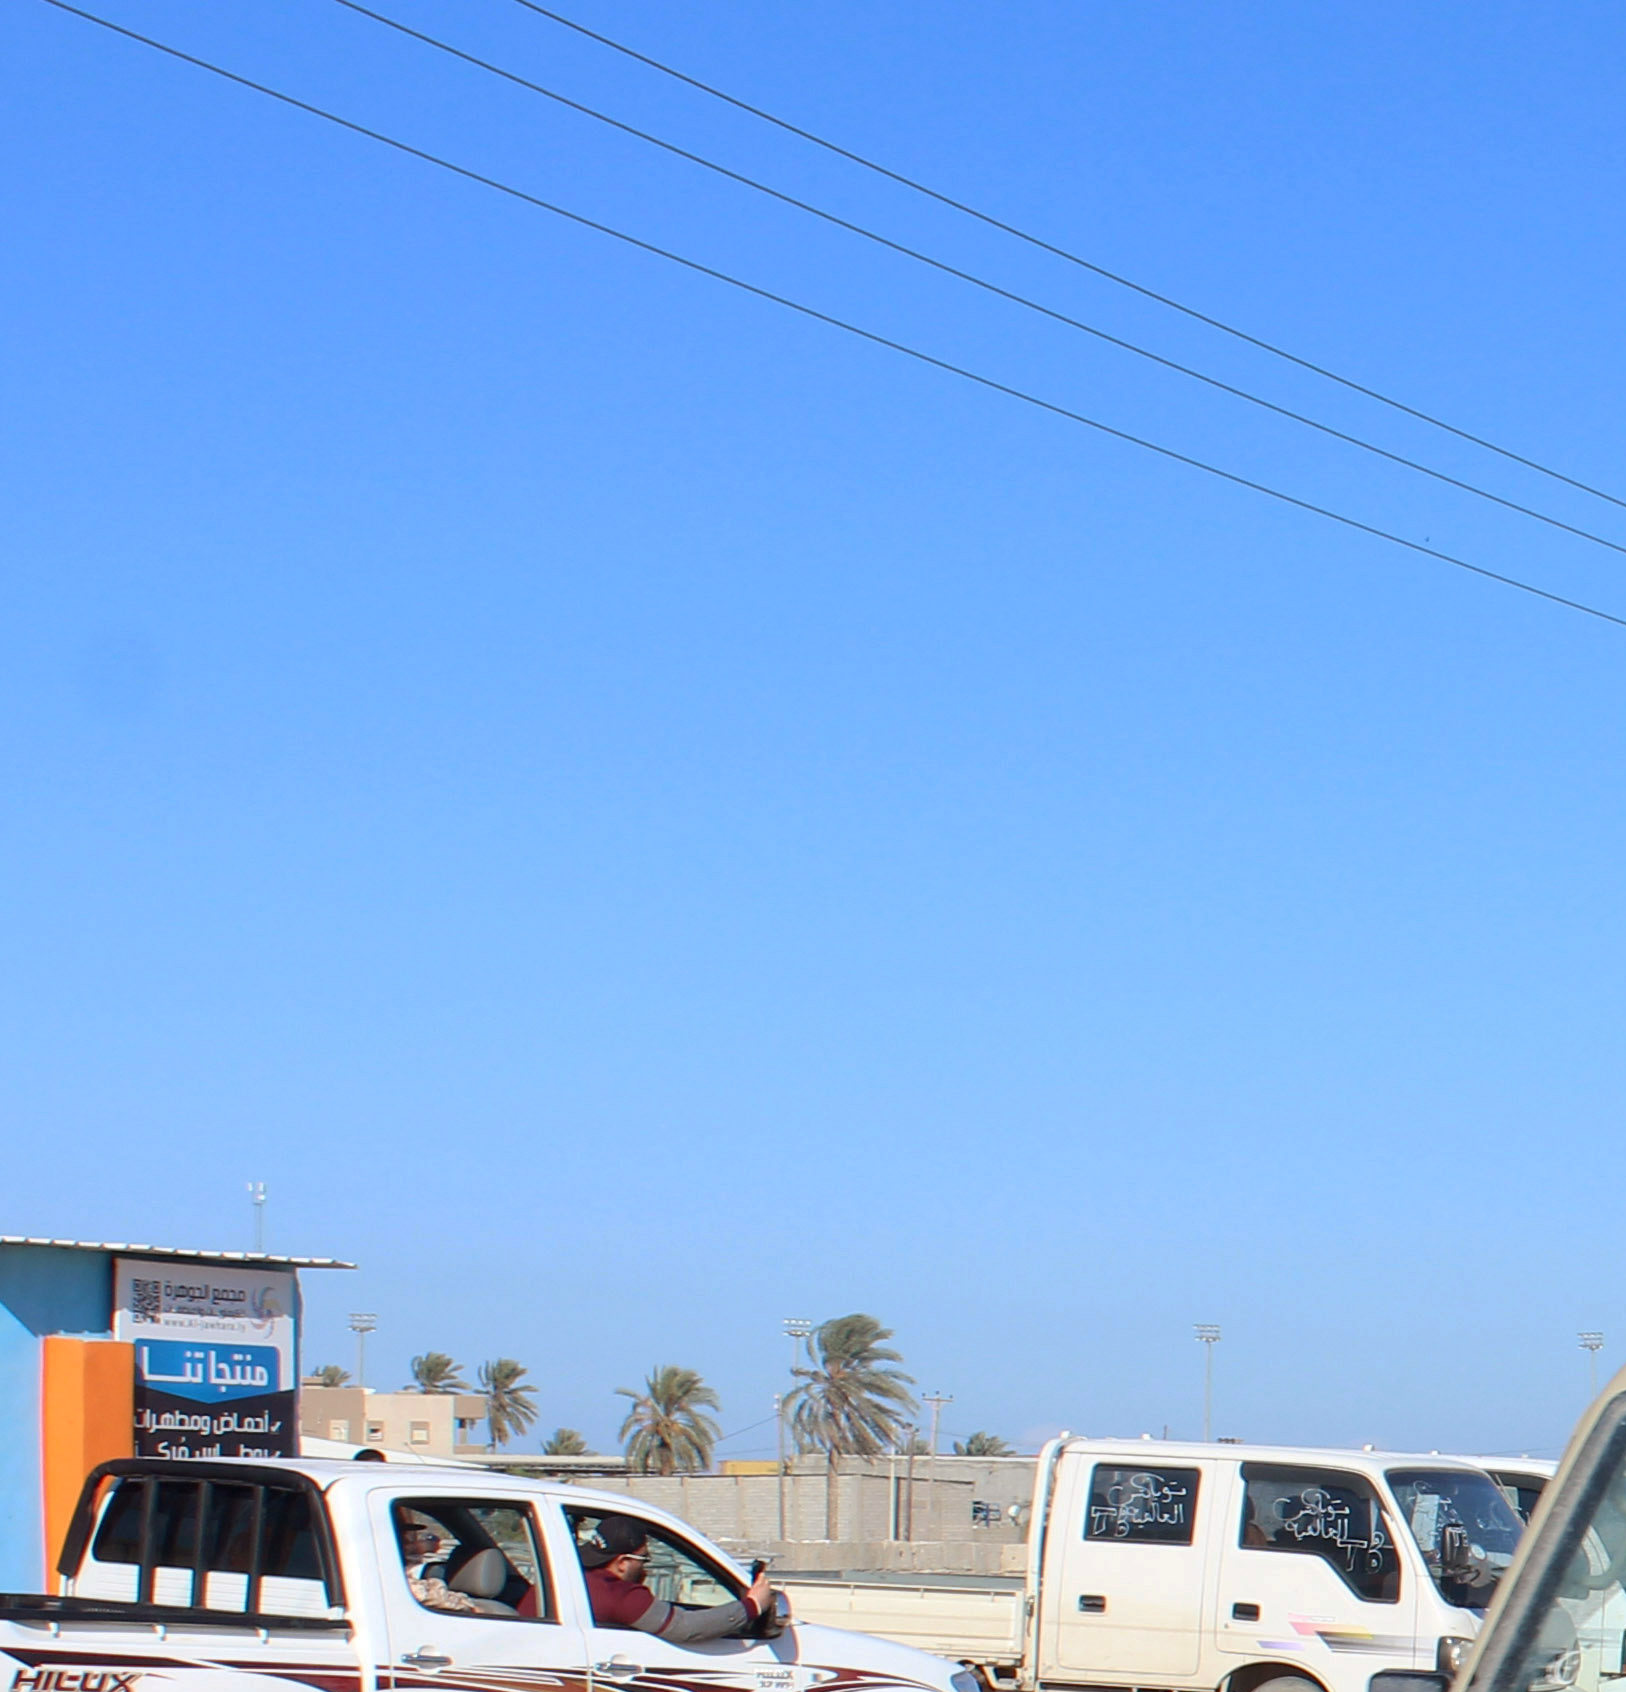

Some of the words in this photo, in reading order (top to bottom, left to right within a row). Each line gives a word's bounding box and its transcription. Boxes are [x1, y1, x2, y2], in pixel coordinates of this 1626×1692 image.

[164, 1280, 210, 1302] الجوهرة
[212, 1286, 246, 1305] مجمع
[141, 1346, 269, 1393] منتجاتنا
[135, 1408, 212, 1436] ومطهرات
[213, 1409, 270, 1435] أحماض
